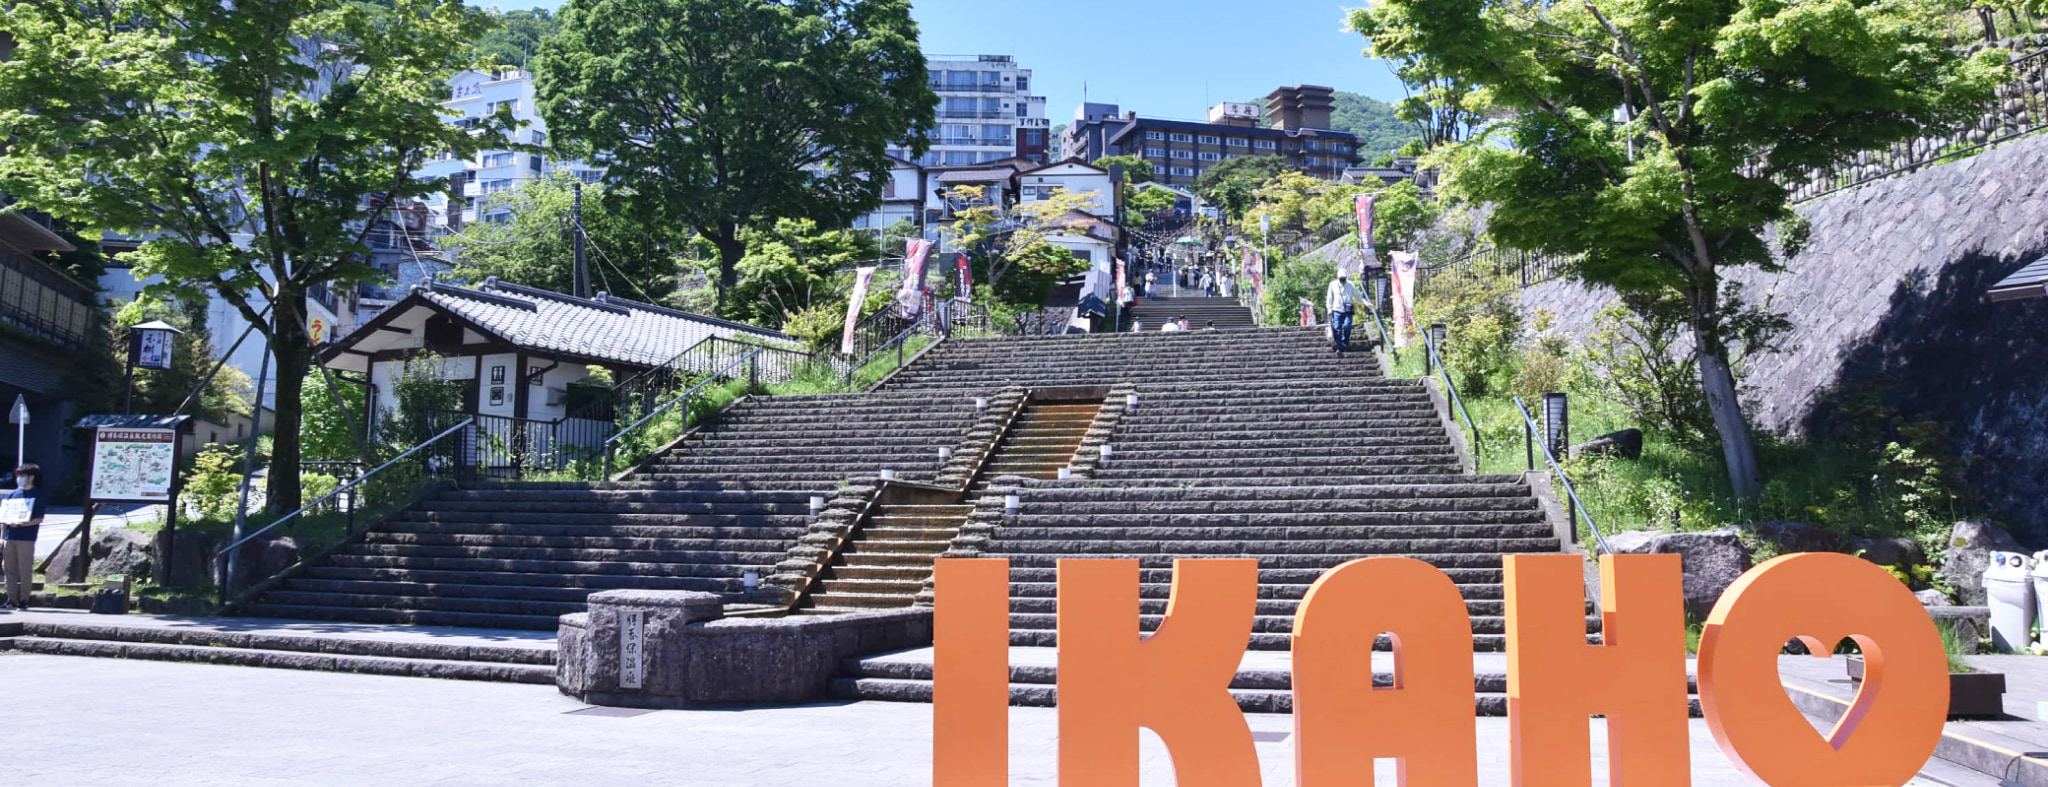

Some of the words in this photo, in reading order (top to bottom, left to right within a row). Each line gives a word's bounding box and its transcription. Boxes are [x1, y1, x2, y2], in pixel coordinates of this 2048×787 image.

[625, 613, 639, 684] 伊香保温泉
[933, 551, 1950, 787] IKAHO
